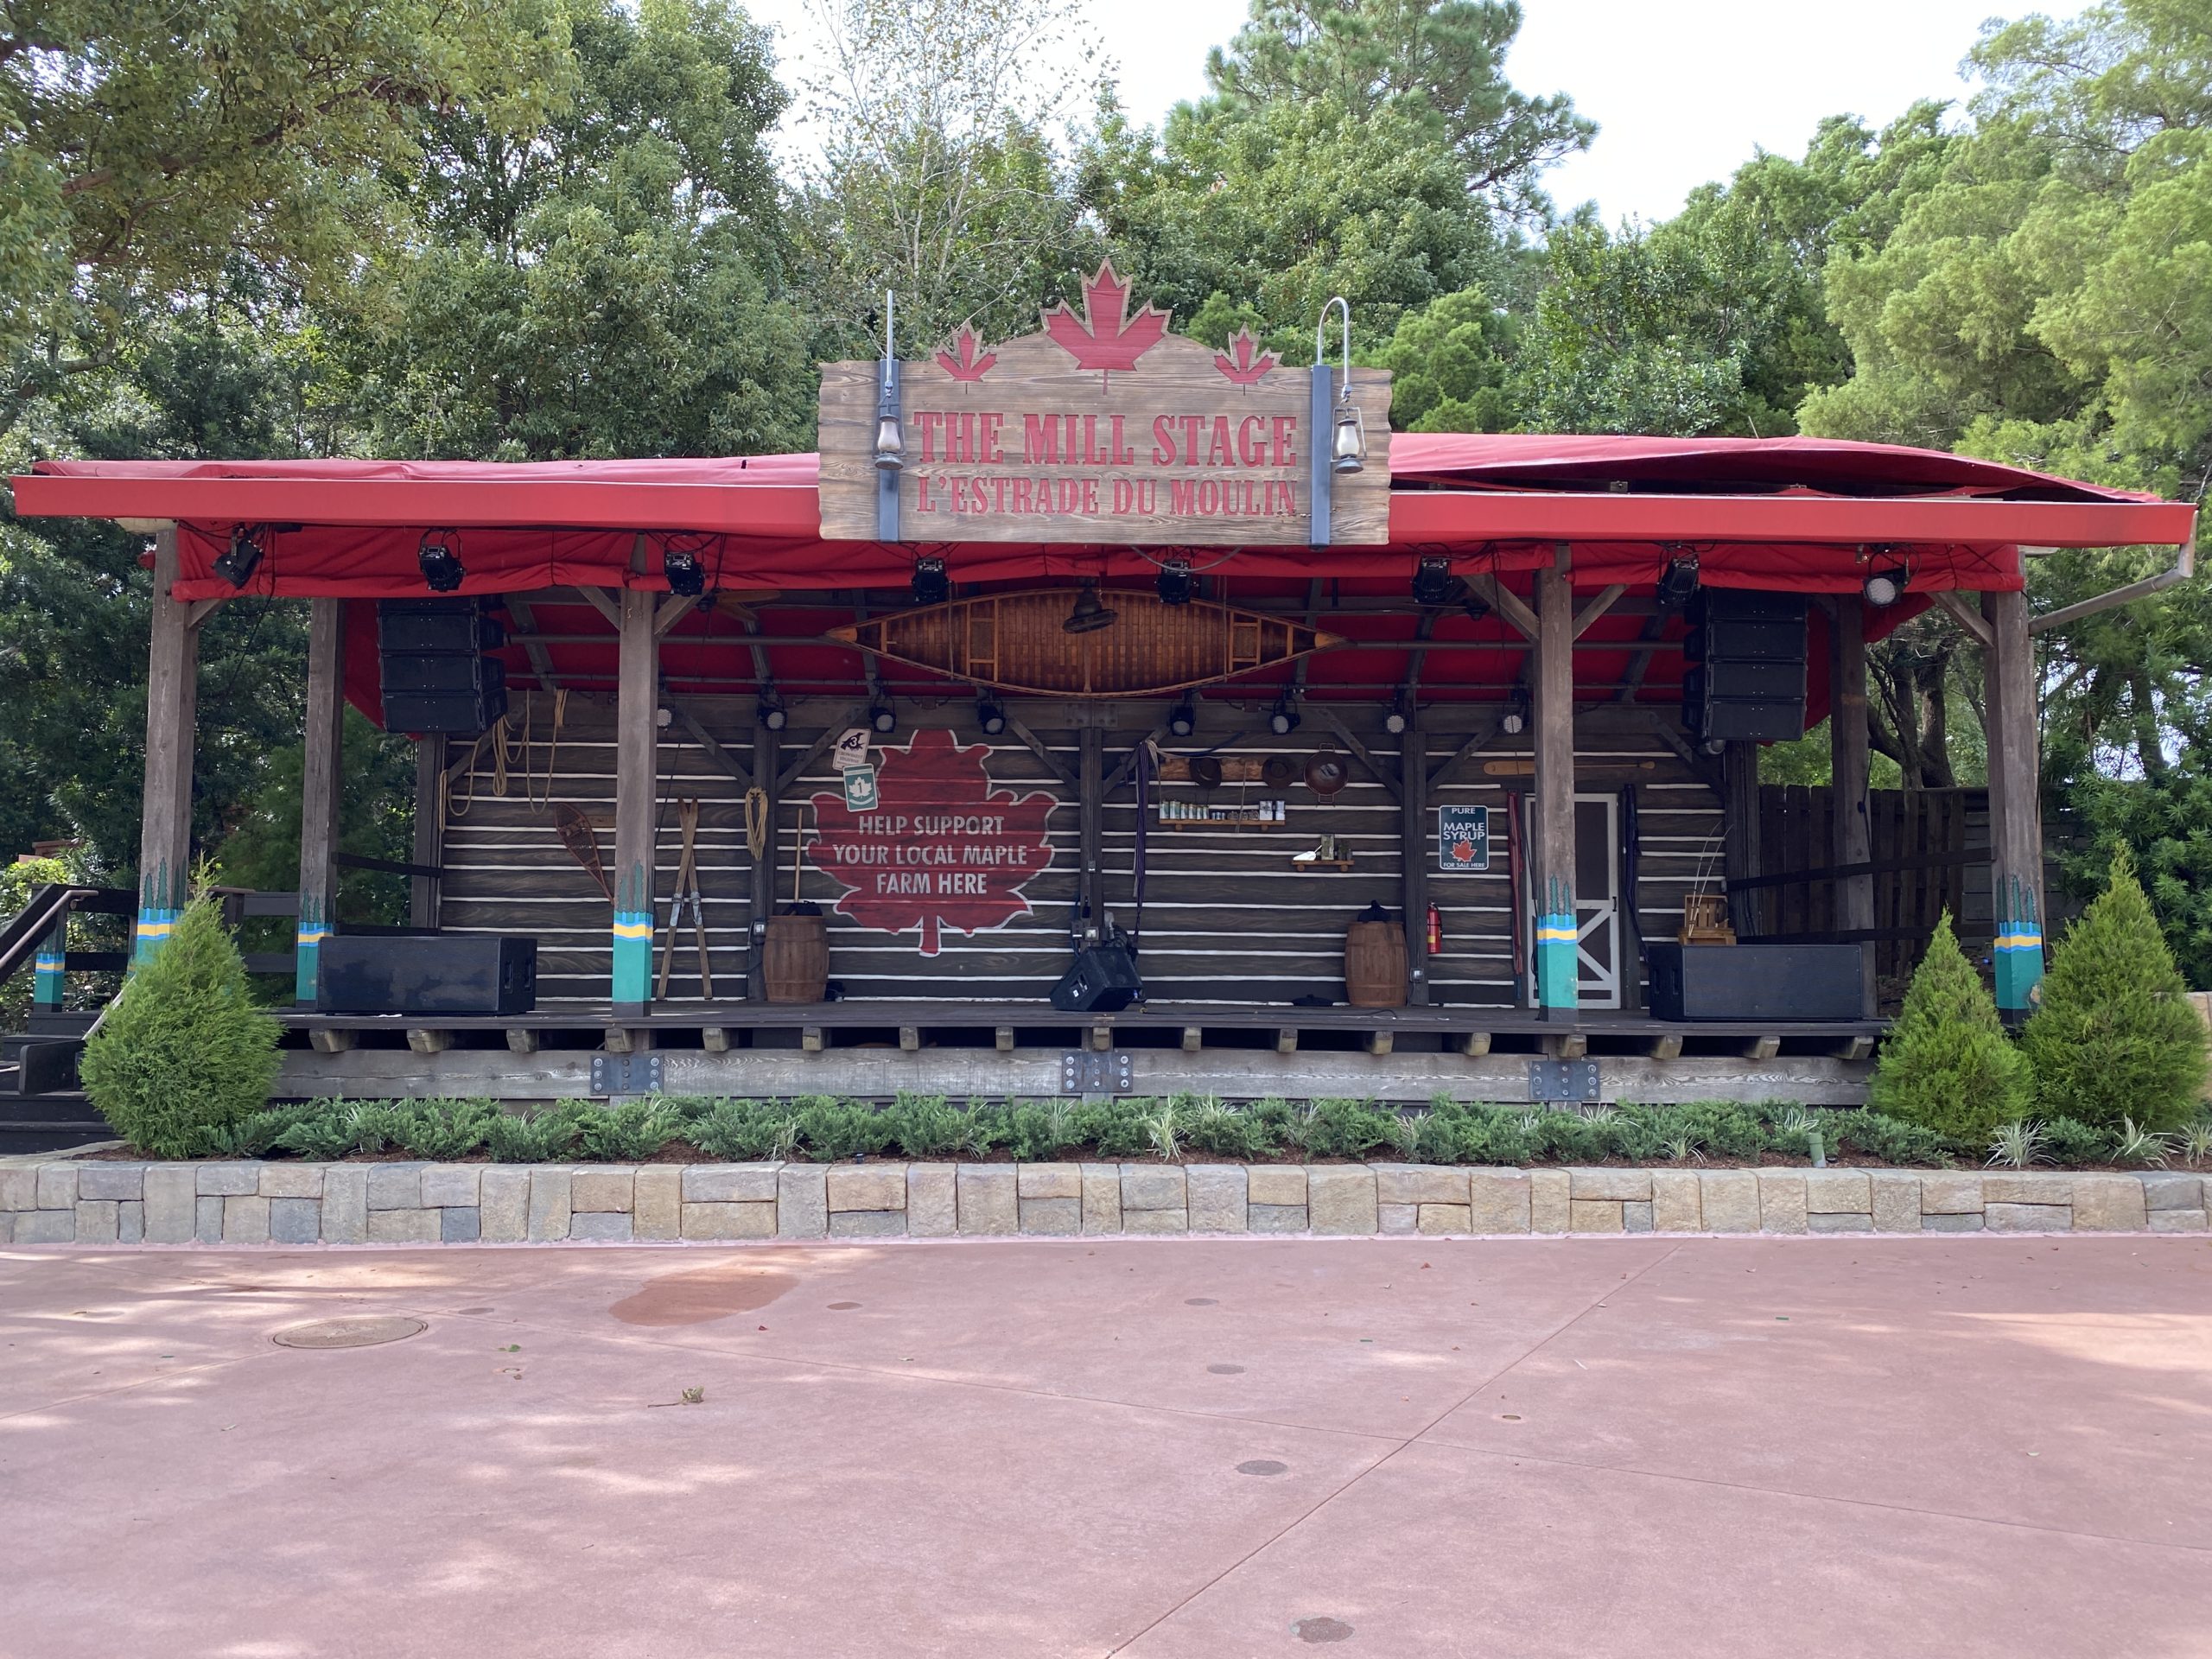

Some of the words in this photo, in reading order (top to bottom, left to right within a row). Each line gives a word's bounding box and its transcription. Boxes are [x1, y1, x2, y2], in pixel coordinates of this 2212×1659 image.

[912, 410, 1004, 464] THE
[1022, 414, 1134, 465] MILL
[1152, 415, 1297, 467] STAGE
[916, 476, 1099, 513] L'ESTRADE
[1112, 478, 1157, 515] DU
[1170, 479, 1298, 518] MOULIN
[849, 736, 858, 747] 3
[858, 782, 862, 793] 1
[858, 816, 907, 836] HELP
[913, 816, 1005, 836] SUPPORT
[1443, 823, 1484, 831] MAPLE
[1443, 831, 1485, 841] SYRUP
[832, 844, 888, 864] YOUR
[895, 845, 957, 865] LOCAL
[963, 845, 1027, 865] MAPLE
[876, 873, 931, 893] FARM
[938, 873, 988, 894] HERE
